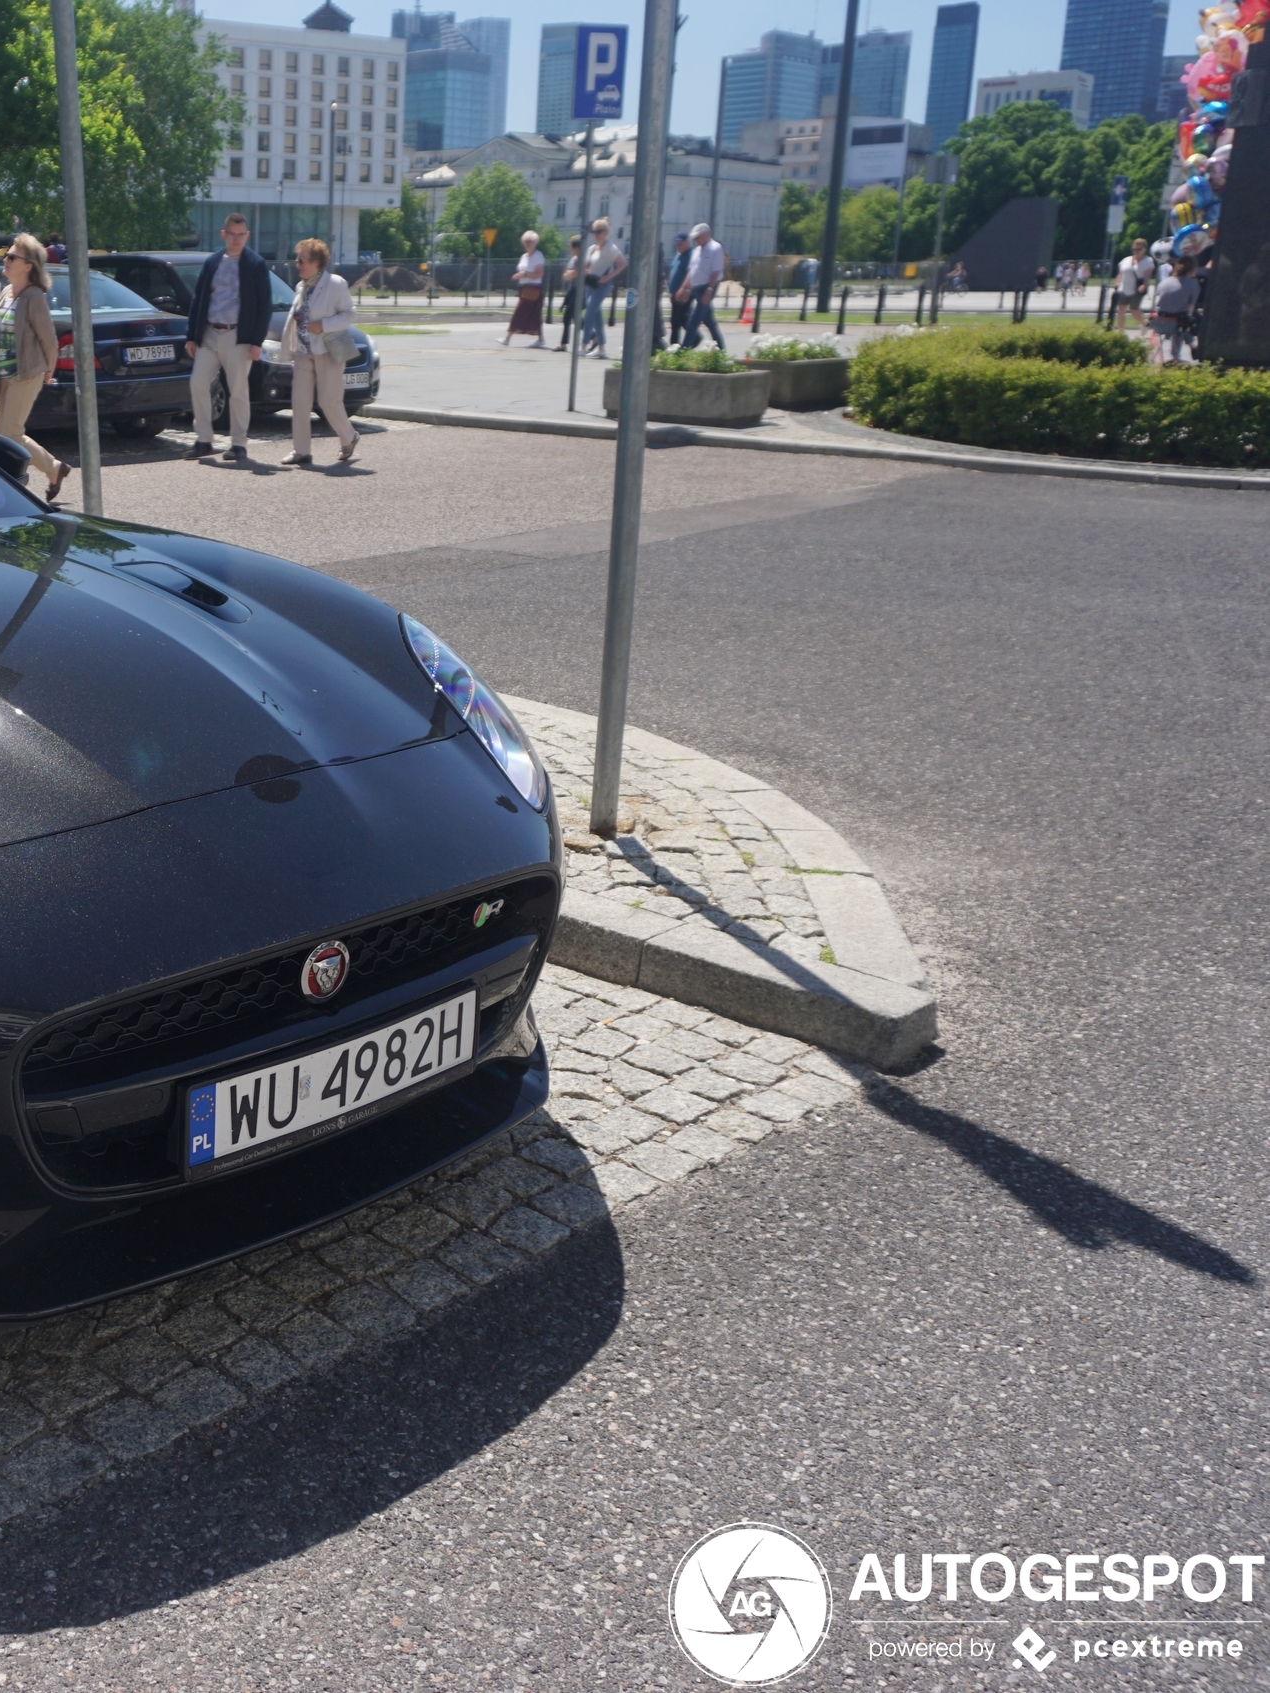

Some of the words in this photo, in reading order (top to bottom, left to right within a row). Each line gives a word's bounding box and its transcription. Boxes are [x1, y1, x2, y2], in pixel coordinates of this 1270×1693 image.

[586, 32, 618, 91] P
[129, 348, 143, 360] WD
[145, 345, 173, 359] 7899F
[230, 1066, 300, 1145] WU
[321, 1002, 464, 1107] 4982H
[347, 1106, 379, 1123] GARAGE
[192, 1133, 212, 1153] PL
[213, 1155, 244, 1171] Professional
[244, 1152, 254, 1161] Car
[253, 1144, 277, 1158] Detailing
[276, 1139, 293, 1150] Studio
